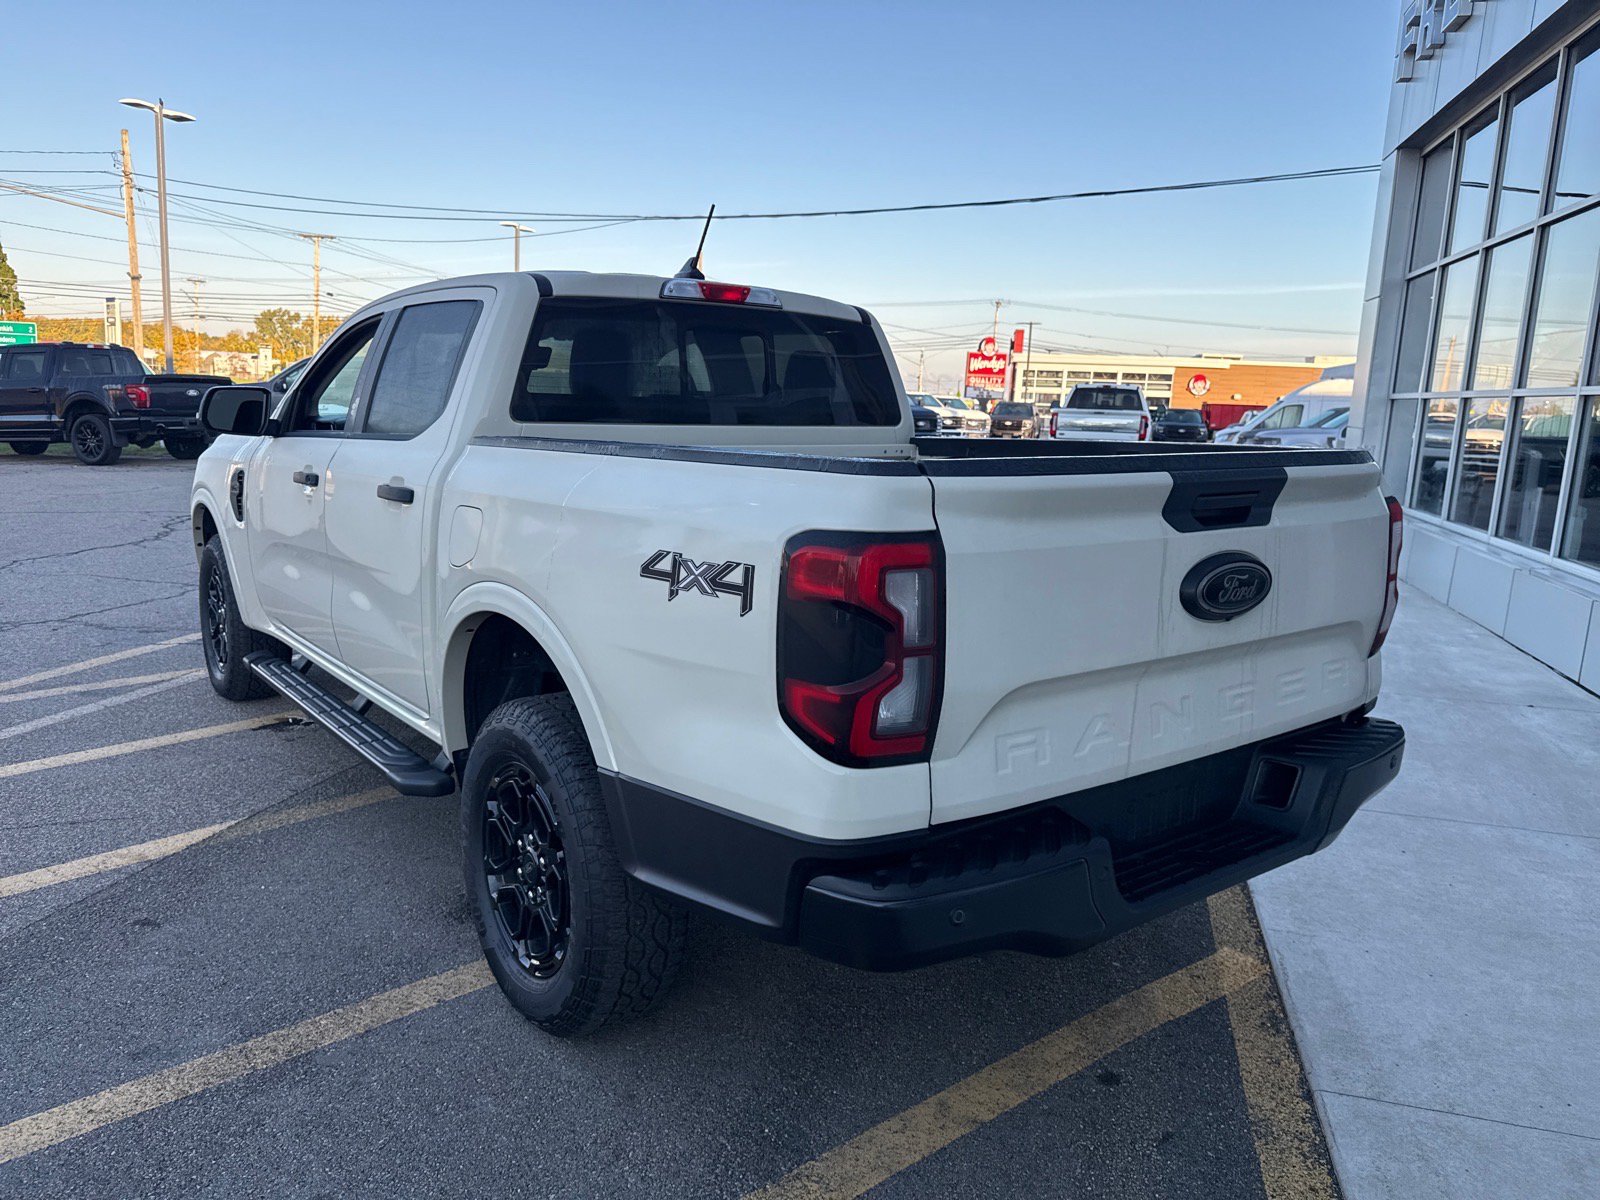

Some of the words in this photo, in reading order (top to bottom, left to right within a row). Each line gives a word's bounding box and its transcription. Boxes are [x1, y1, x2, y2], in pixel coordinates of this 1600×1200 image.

[969, 355, 1005, 373] Wendy's
[969, 376, 1003, 384] QUALITY
[1218, 574, 1258, 603] Ford
[994, 658, 1351, 775] RANGER
